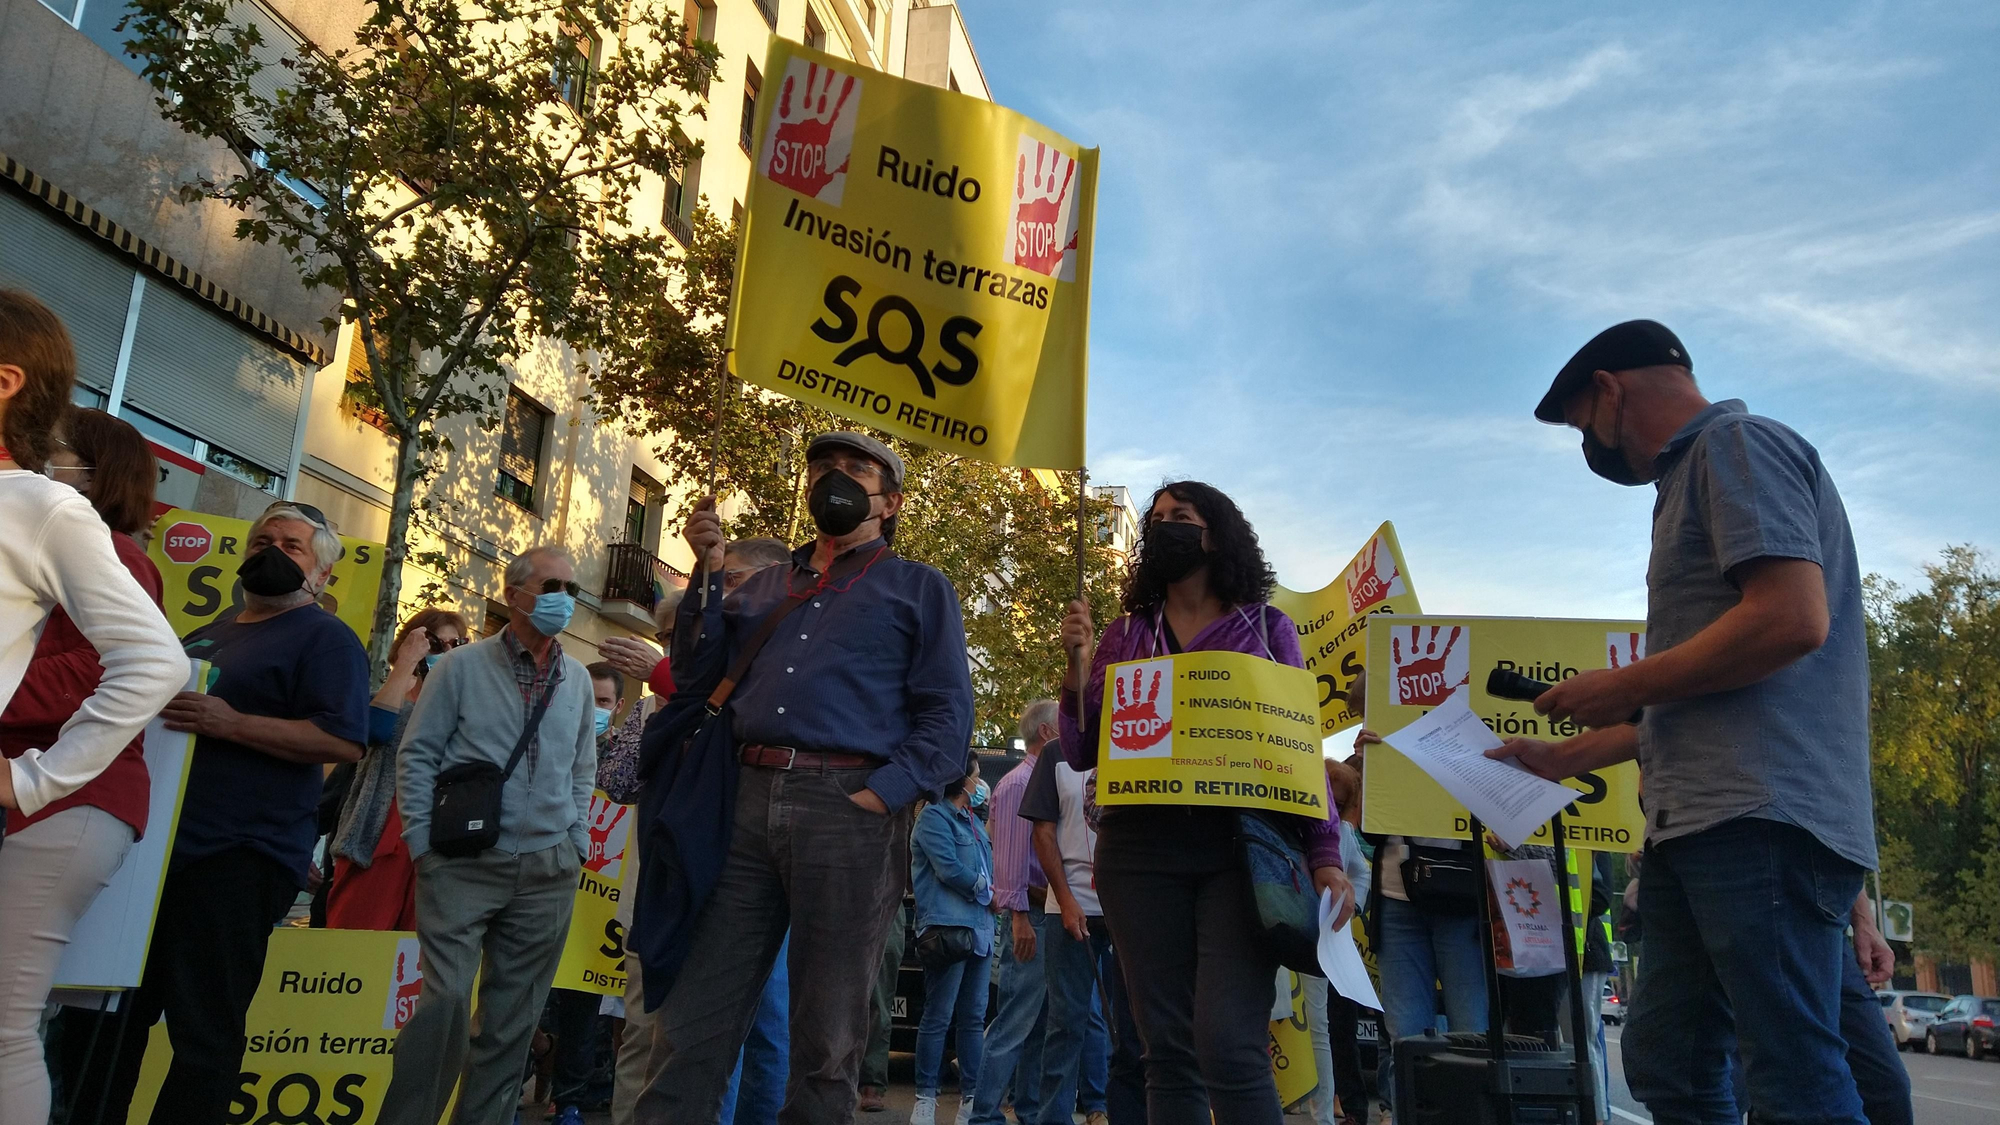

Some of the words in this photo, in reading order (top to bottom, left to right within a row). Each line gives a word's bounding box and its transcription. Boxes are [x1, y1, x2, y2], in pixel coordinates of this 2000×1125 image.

[773, 139, 826, 180] STOP
[876, 145, 981, 203] Ruido
[1016, 221, 1056, 259] STOP
[782, 198, 912, 273] Invasión
[923, 249, 1050, 311] terrazas
[777, 358, 891, 415] DISTRITO
[896, 402, 989, 447] RETIRO
[169, 535, 207, 548] STOP
[1352, 576, 1380, 609] STOP
[1297, 609, 1335, 636] uido
[1188, 670, 1231, 681] RUIDO
[1400, 671, 1443, 700] STOP
[1188, 697, 1251, 711] INVASIÓN
[1255, 702, 1315, 725] TERRAZAS
[1111, 718, 1163, 739] STOP
[1189, 728, 1253, 741] EXCESOS
[1256, 733, 1265, 743] Y
[1267, 734, 1315, 754] ABUSOS
[1170, 758, 1213, 767] TERRAZAS
[1215, 754, 1226, 767] SÍ
[1230, 760, 1251, 770] pero
[1253, 758, 1273, 771] NO
[1276, 763, 1293, 775] así
[1107, 780, 1183, 795] BARRIO
[1194, 781, 1321, 808] RETIRO/IBIZA
[578, 872, 621, 903] Inva
[279, 971, 363, 994] Ruido
[397, 995, 419, 1023] ST
[244, 1028, 309, 1053] sión
